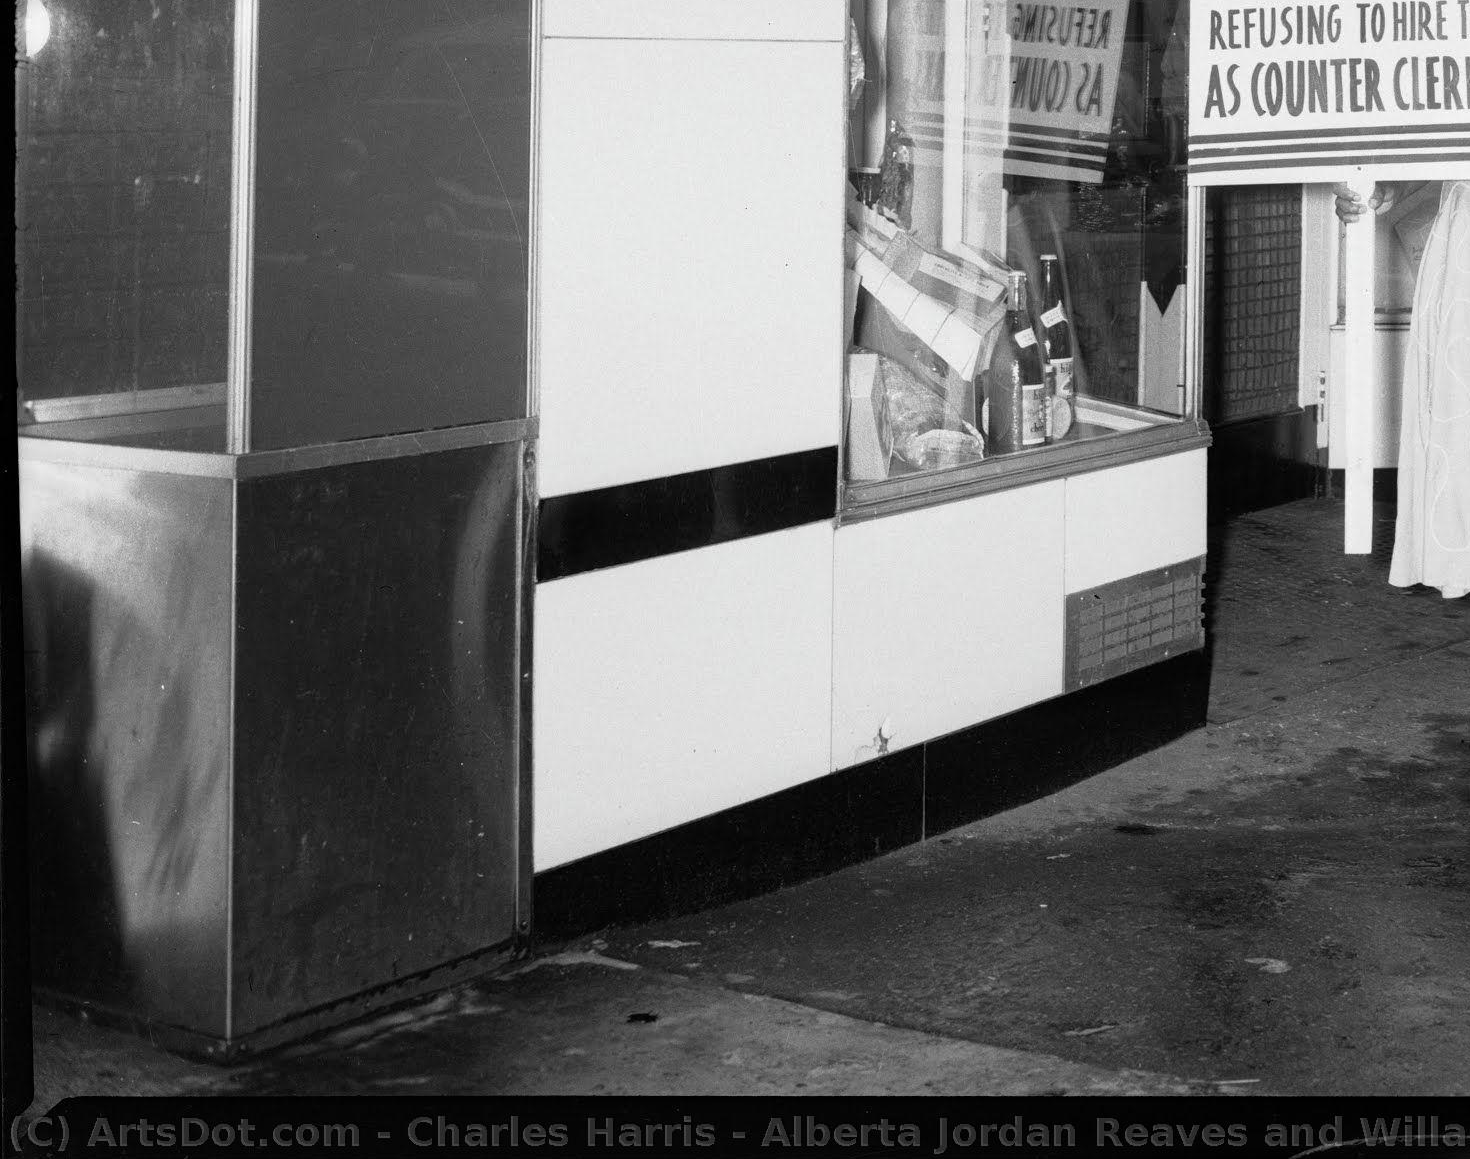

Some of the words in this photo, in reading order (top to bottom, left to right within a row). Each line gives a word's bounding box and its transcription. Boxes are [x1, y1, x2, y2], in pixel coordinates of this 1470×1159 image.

[1210, 4, 1341, 50] REFUSING
[1357, 3, 1385, 43] TO
[1393, 1, 1448, 41] HIRE
[1204, 64, 1240, 118] AS
[1251, 58, 1385, 116] COUNTER
